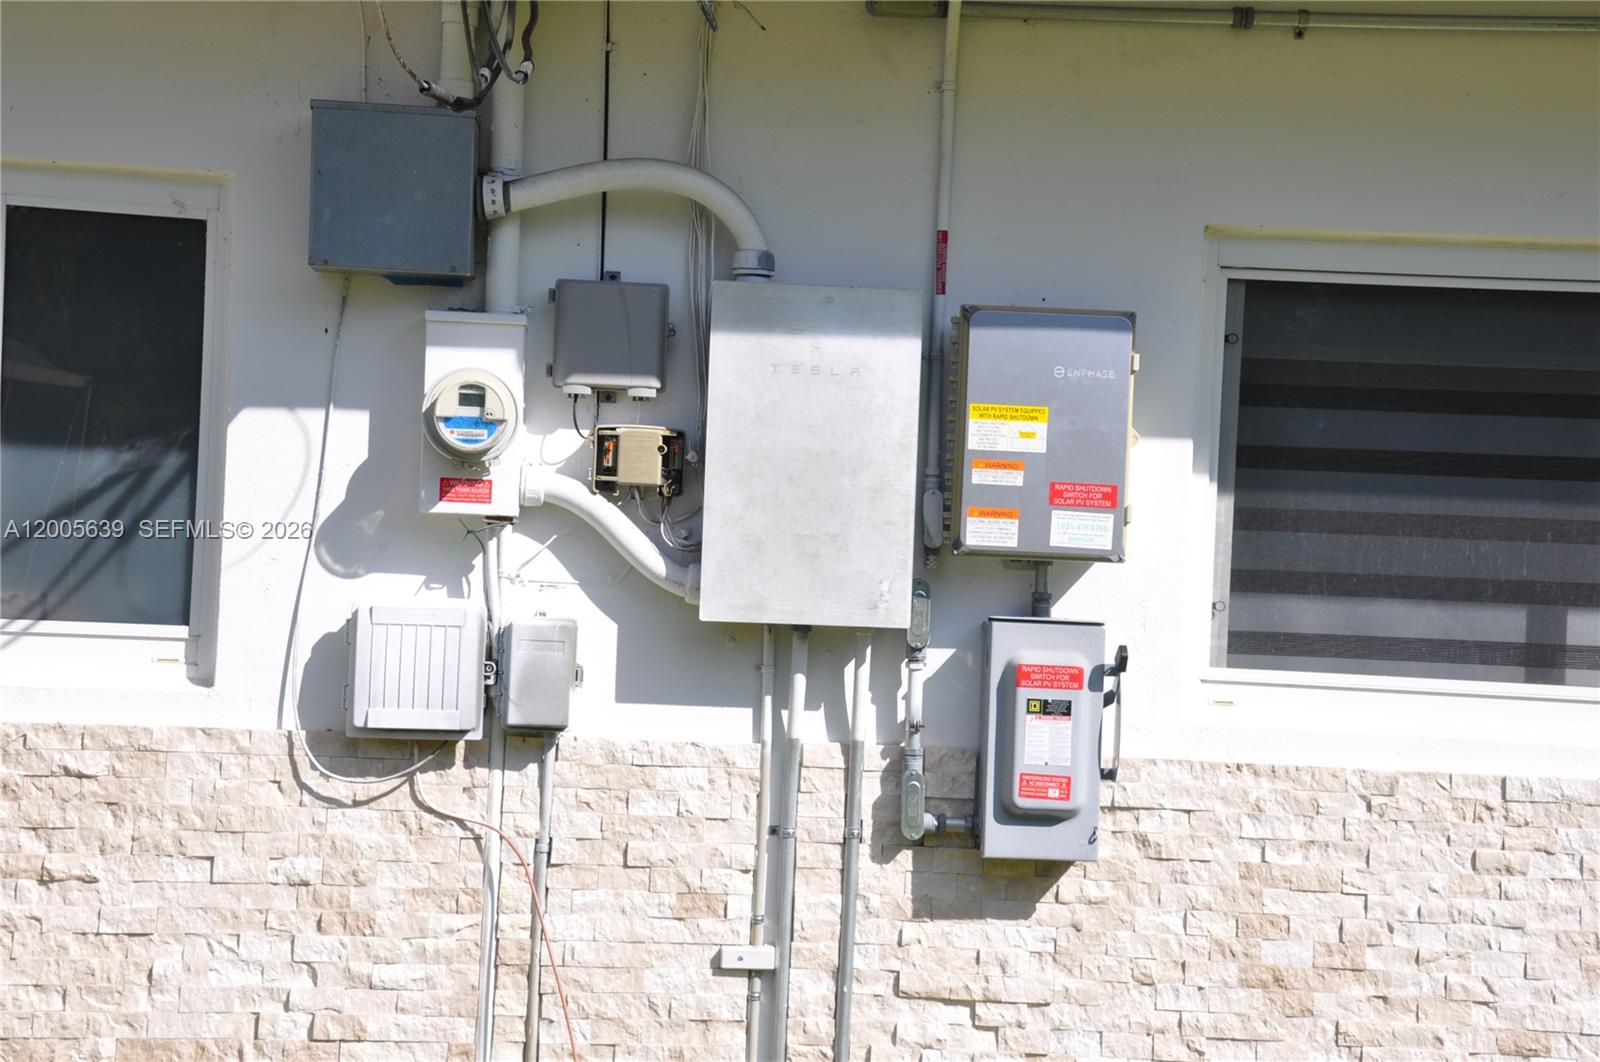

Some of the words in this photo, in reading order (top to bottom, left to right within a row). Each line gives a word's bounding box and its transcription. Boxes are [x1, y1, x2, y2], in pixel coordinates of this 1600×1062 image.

[1066, 368, 1117, 380] ENPHASE
[998, 406, 1020, 414] SYSTEM
[1020, 407, 1046, 415] EQUIPPED
[984, 462, 1020, 470] WARNING
[1054, 483, 1074, 491] RAPID
[1074, 485, 1112, 493] SHUTDOWN
[1062, 491, 1088, 499] SWITCH
[1088, 492, 1103, 500] FOR
[1075, 498, 1085, 506] PV
[1085, 499, 1112, 507] SYSTEM
[979, 510, 1014, 518] WARNING
[1021, 665, 1042, 673] RAPID
[1042, 666, 1079, 675] SHUTDOWN
[1020, 679, 1042, 687] SOLAR
[1042, 680, 1052, 688] PV
[1052, 681, 1079, 689] SYSTEM
